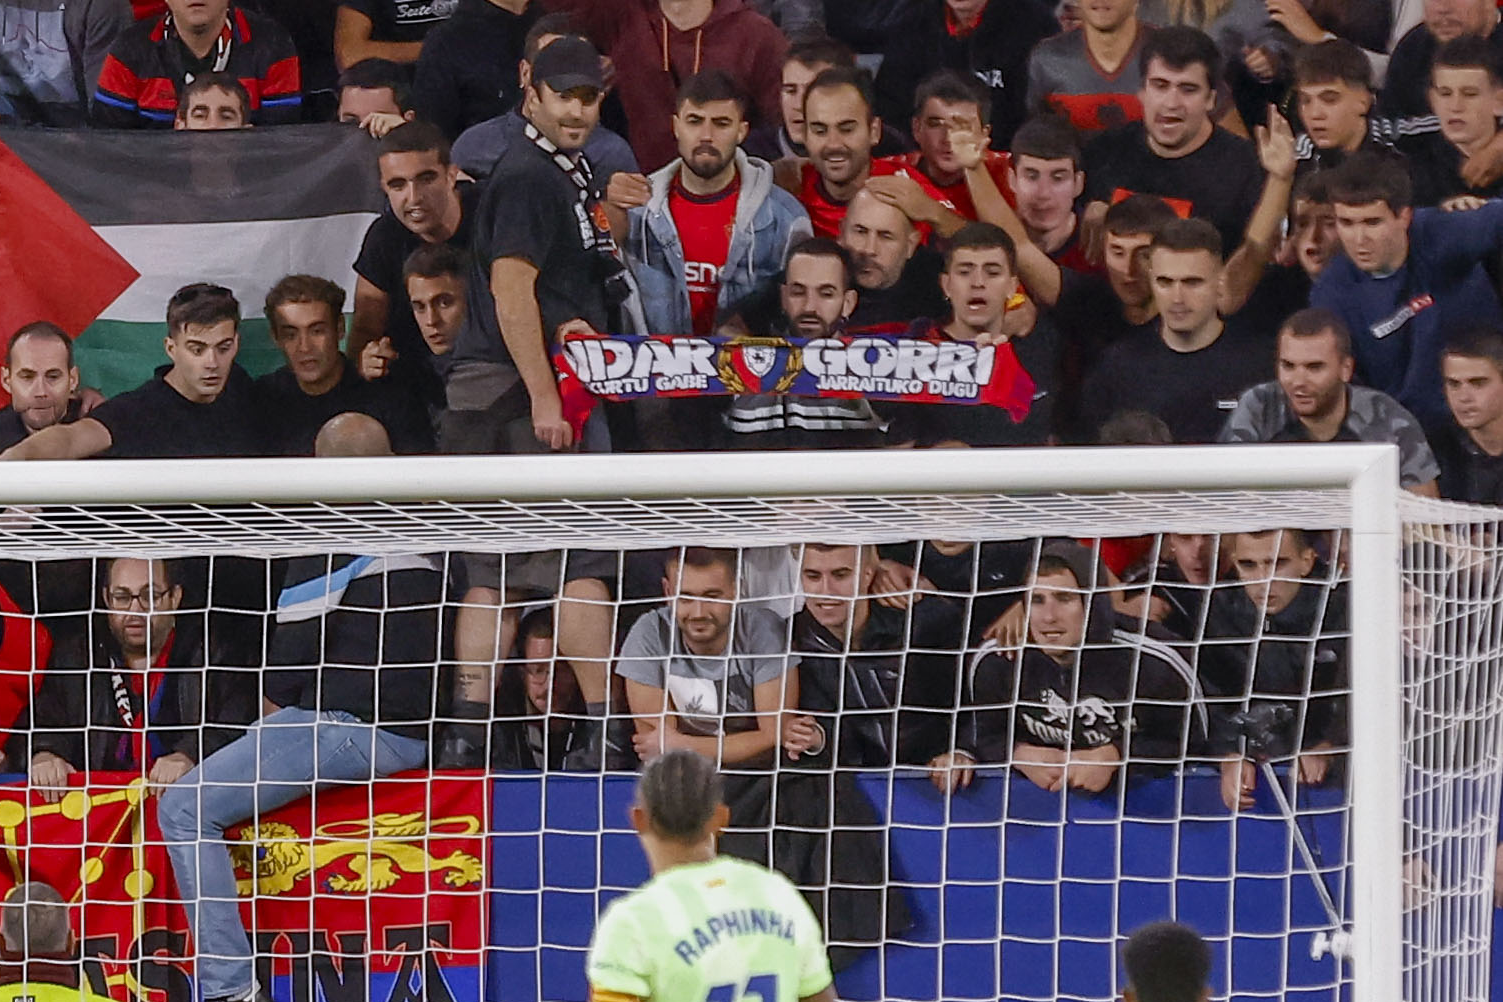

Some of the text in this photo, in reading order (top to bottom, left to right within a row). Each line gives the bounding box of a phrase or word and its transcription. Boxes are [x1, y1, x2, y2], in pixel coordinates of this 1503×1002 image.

[802, 338, 995, 385] GORRI
[655, 374, 708, 392] GABE
[815, 374, 923, 395] JARRAITUKO
[928, 380, 978, 399] DUGU
[674, 908, 795, 966] RAPHINHA
